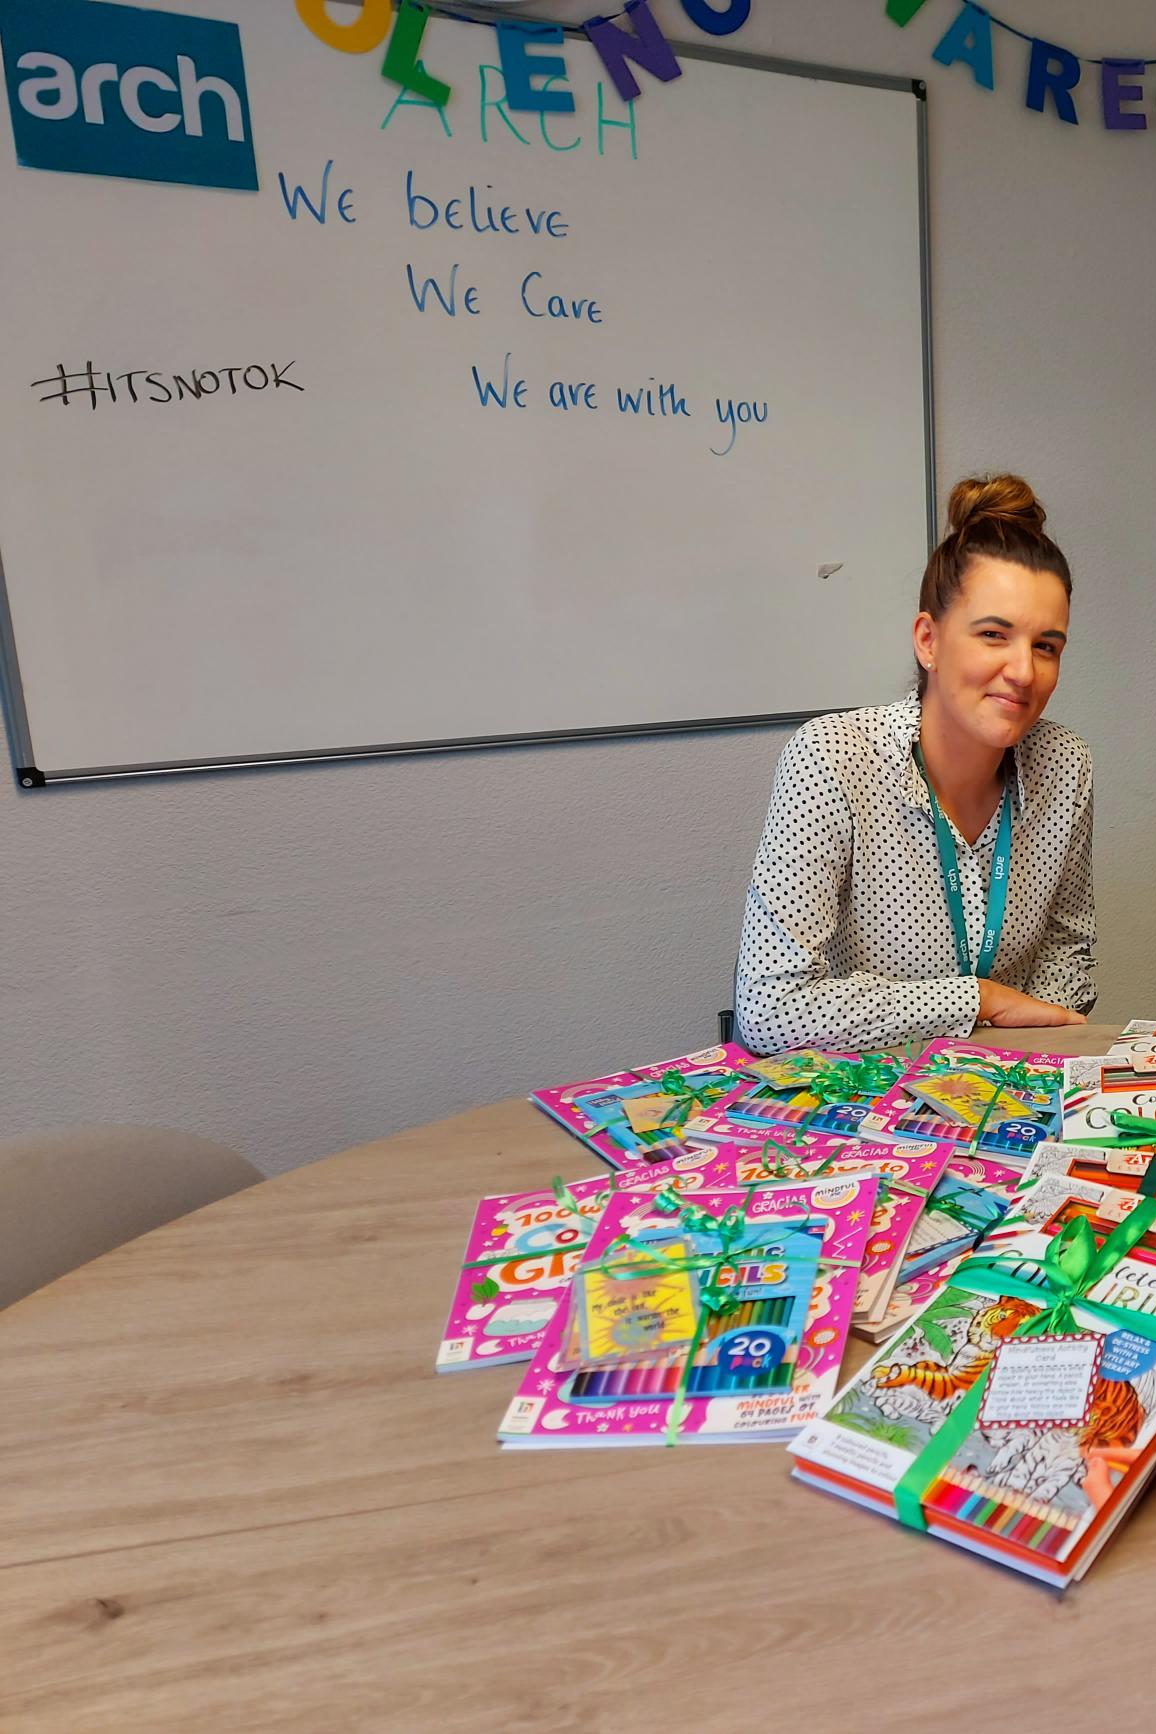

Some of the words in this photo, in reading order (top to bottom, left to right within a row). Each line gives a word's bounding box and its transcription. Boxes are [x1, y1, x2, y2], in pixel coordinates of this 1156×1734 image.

[17, 51, 245, 143] arch
[381, 60, 637, 160] ARCH
[278, 161, 357, 224] We
[406, 171, 569, 238] believe
[405, 264, 481, 316] We
[520, 271, 603, 324] Care
[31, 360, 305, 410] #ITSNOTOK
[472, 352, 529, 410] We
[549, 378, 599, 411] are
[616, 376, 691, 418] with
[711, 397, 769, 454] you
[994, 855, 1005, 880] arch
[983, 929, 996, 953] arch
[836, 1106, 867, 1117] 20
[1006, 1123, 1036, 1136] 20
[841, 1147, 889, 1160] GRACIAS
[619, 1166, 670, 1188] GRACIAS
[814, 1181, 856, 1198] MINDFUL
[752, 1193, 807, 1214] GRACIAS
[727, 1336, 772, 1357] 20
[1112, 1338, 1150, 1355] DE-STRESS
[1121, 1332, 1145, 1345] RELAX
[1112, 1346, 1133, 1360] WITH
[1131, 1353, 1139, 1361] A
[1124, 1358, 1141, 1369] ART
[736, 1396, 796, 1411] MINDFUL
[757, 1404, 795, 1416] PAGES
[576, 1407, 625, 1426] THANK
[628, 1403, 661, 1418] YOU
